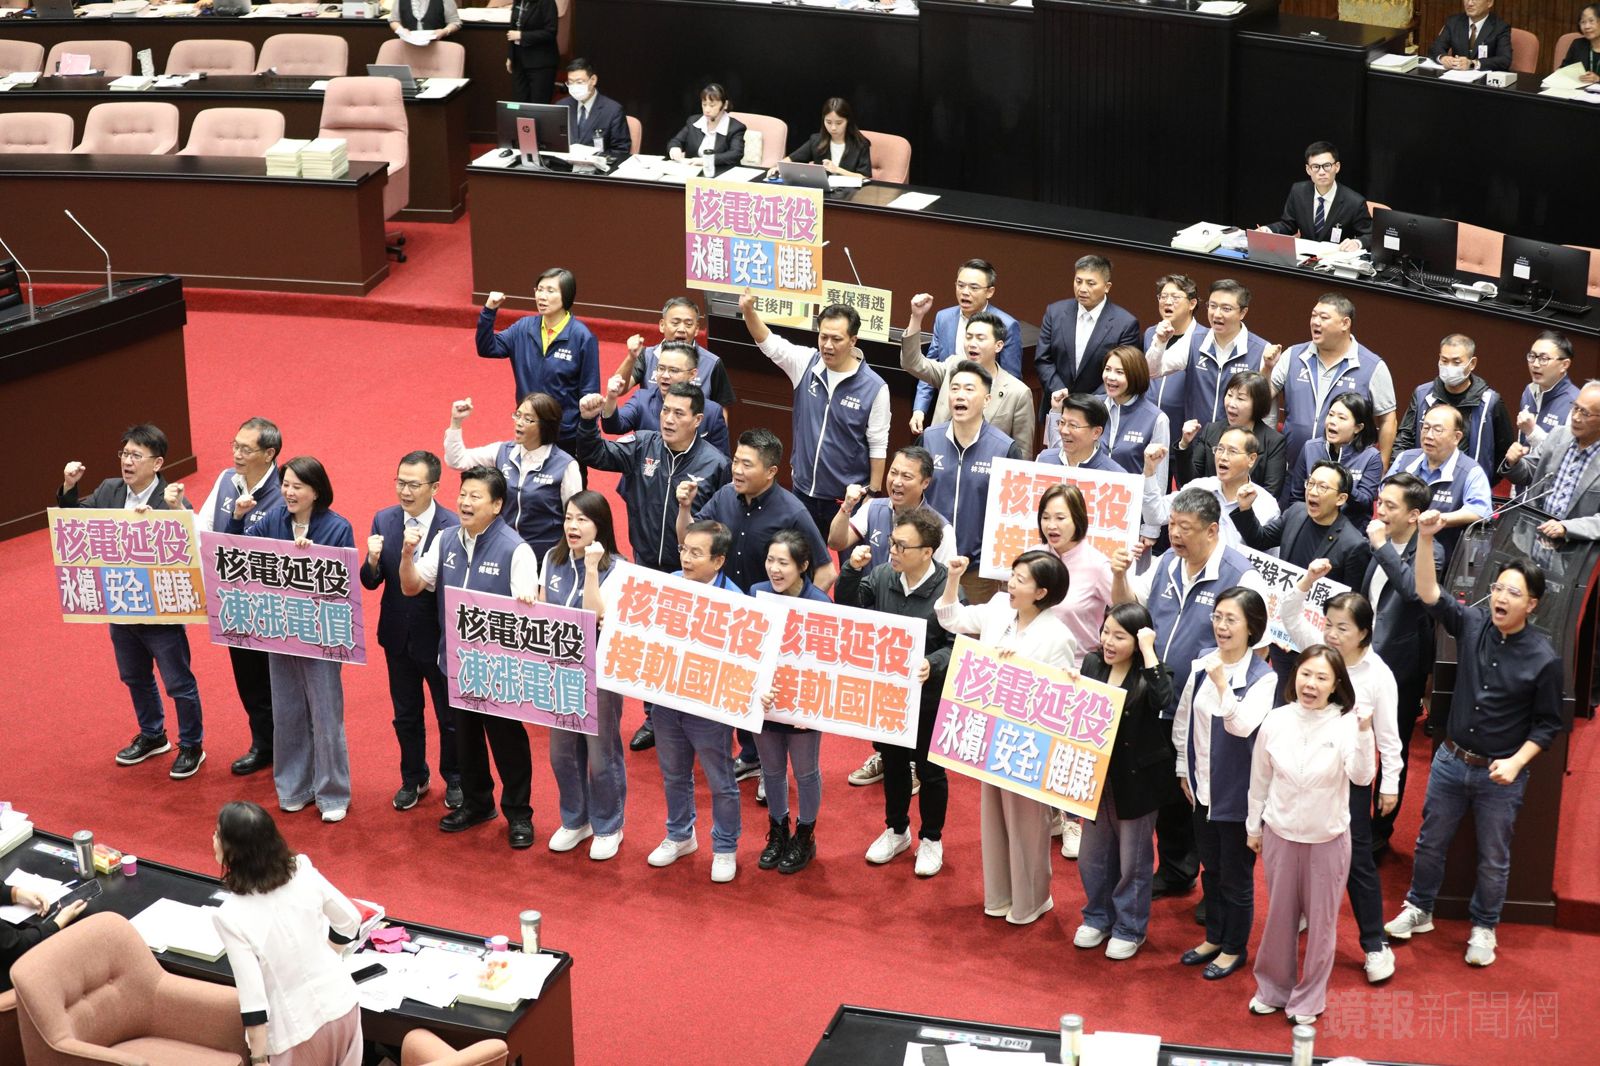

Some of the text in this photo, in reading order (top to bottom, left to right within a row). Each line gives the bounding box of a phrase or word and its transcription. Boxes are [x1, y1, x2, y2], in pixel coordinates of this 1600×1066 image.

[691, 187, 817, 242] 核電延役
[691, 234, 817, 291] 永續! 安全! 健康!
[827, 288, 885, 312] 棄保潛逃
[54, 518, 192, 565] 核電延役
[214, 544, 351, 597] 核電延役
[61, 568, 201, 613] 永續! 安全! 健康!
[1247, 554, 1332, 607] 核綠不廢
[217, 587, 356, 649] 凍漲電價
[456, 602, 584, 663] 核電延役
[617, 575, 771, 663] 核電延役
[456, 647, 589, 719] 凍漲電價
[604, 629, 758, 718] 接軌國際
[953, 649, 1113, 749] 核電延役
[937, 703, 1097, 802] 永續! 安全! 健康!
